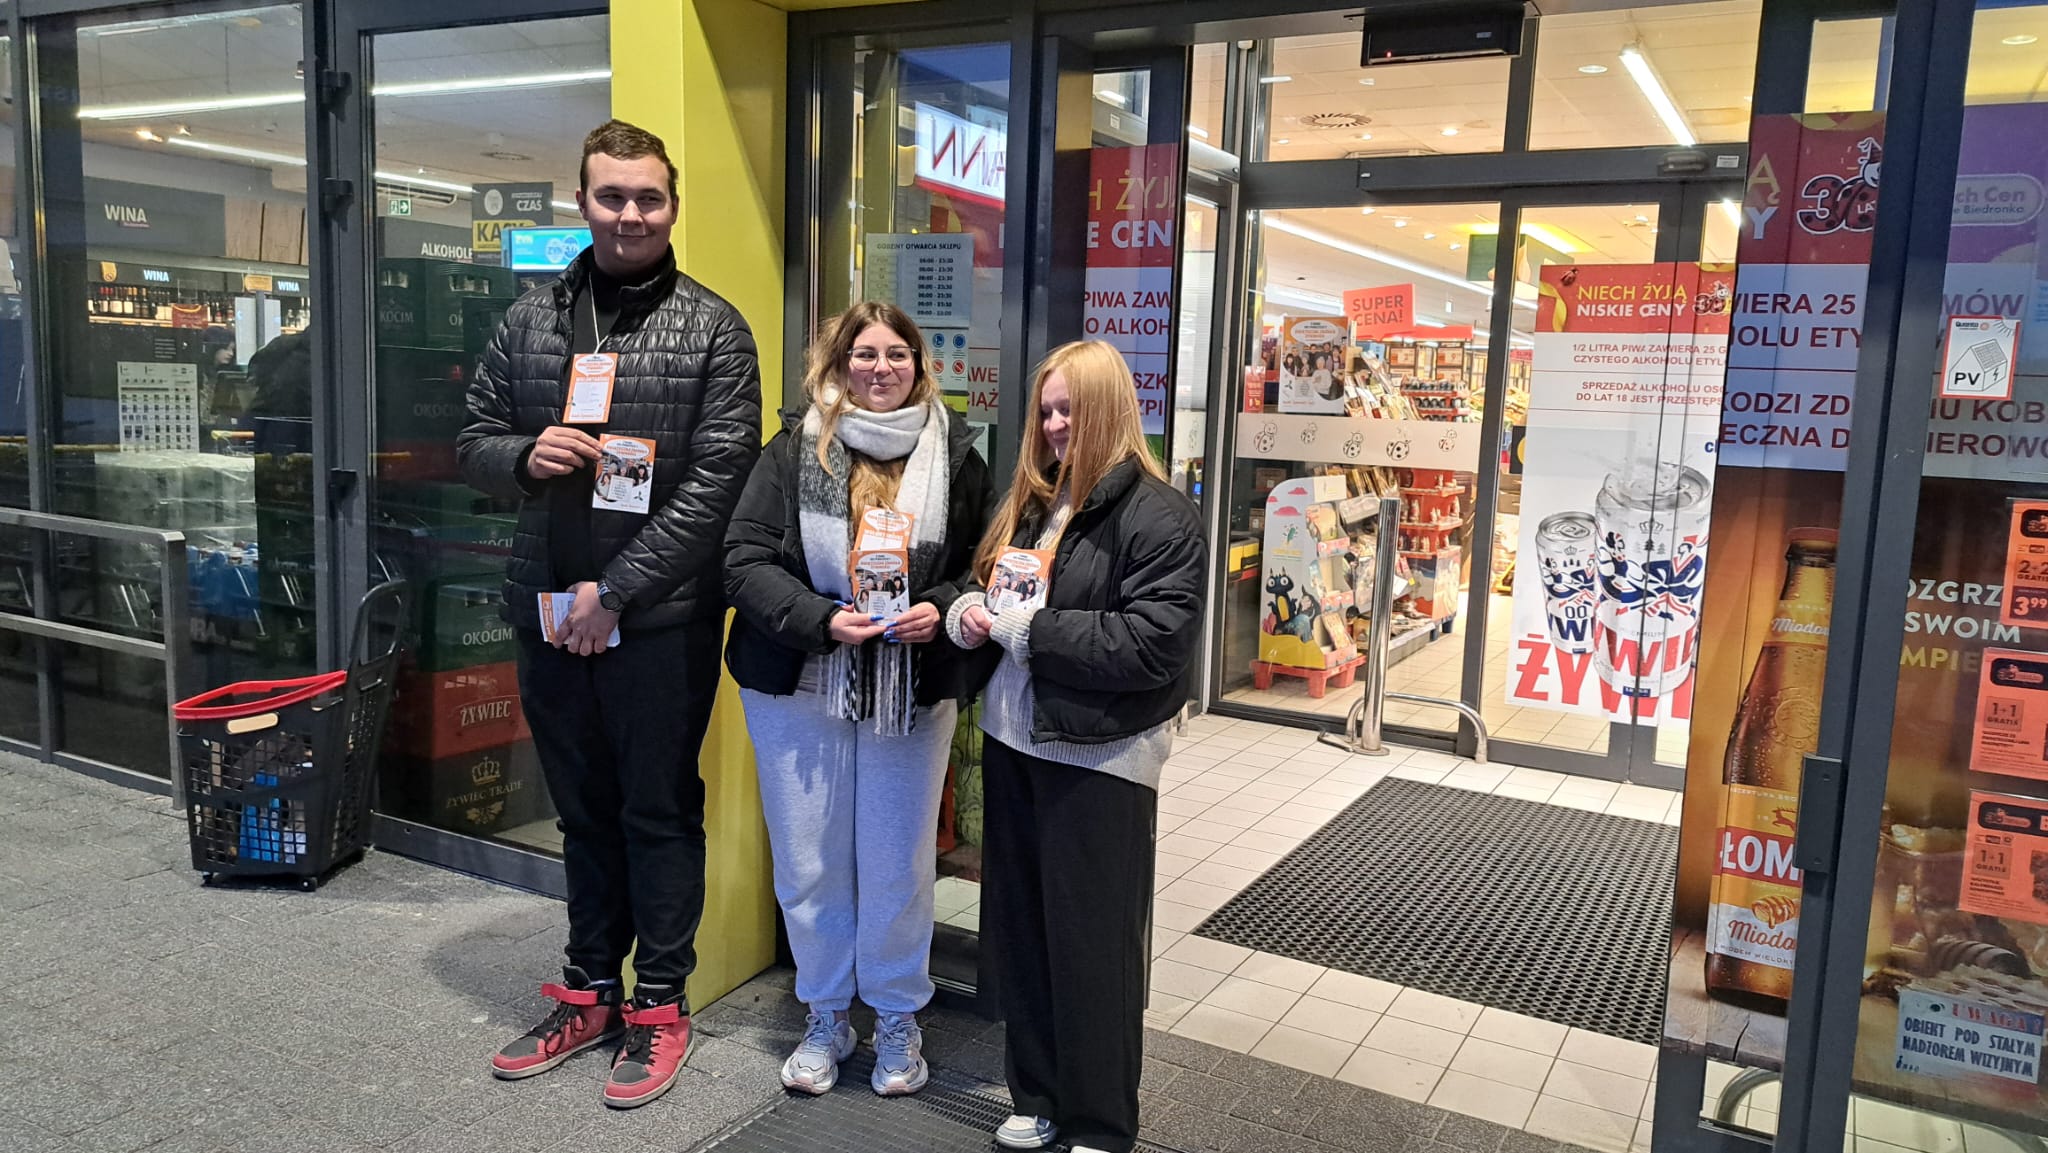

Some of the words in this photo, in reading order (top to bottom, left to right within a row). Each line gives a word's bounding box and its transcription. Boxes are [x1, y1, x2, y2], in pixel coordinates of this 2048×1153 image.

[1116, 169, 1176, 210] ŻYJ
[1984, 186, 2025, 203] Cen
[104, 204, 148, 223] WINA
[516, 200, 543, 212] CZAS
[143, 269, 169, 282] WINA
[278, 280, 300, 292] WINA
[1577, 285, 1636, 301] NIECH
[1642, 281, 1688, 303] ŻYJĄ
[1352, 295, 1404, 312] SUPER
[1577, 303, 1633, 317] NISKIE
[1821, 294, 1856, 315] 25
[1353, 310, 1403, 327] CENA!
[1573, 344, 1587, 352] 1/2
[1589, 344, 1619, 352] LITRA
[1648, 345, 1700, 354] ZAWIERA
[1703, 346, 1716, 354] 25
[1573, 356, 1630, 364] CZYSTEGO
[1695, 357, 1726, 366] ETYL
[1582, 381, 1637, 391] SPRZEDAŻ
[1954, 372, 1981, 386] PV
[967, 388, 999, 411] IĄŻ
[1576, 393, 1592, 401] DO
[1594, 394, 1613, 402] LAT
[1630, 395, 1654, 404] JEST
[1904, 611, 2021, 644] SWOIM
[462, 627, 513, 646] OKOCIM
[1904, 1017, 1947, 1038] OBIEKT
[1954, 1026, 1980, 1045] POD
[1902, 1035, 1965, 1063] NADZOREM
